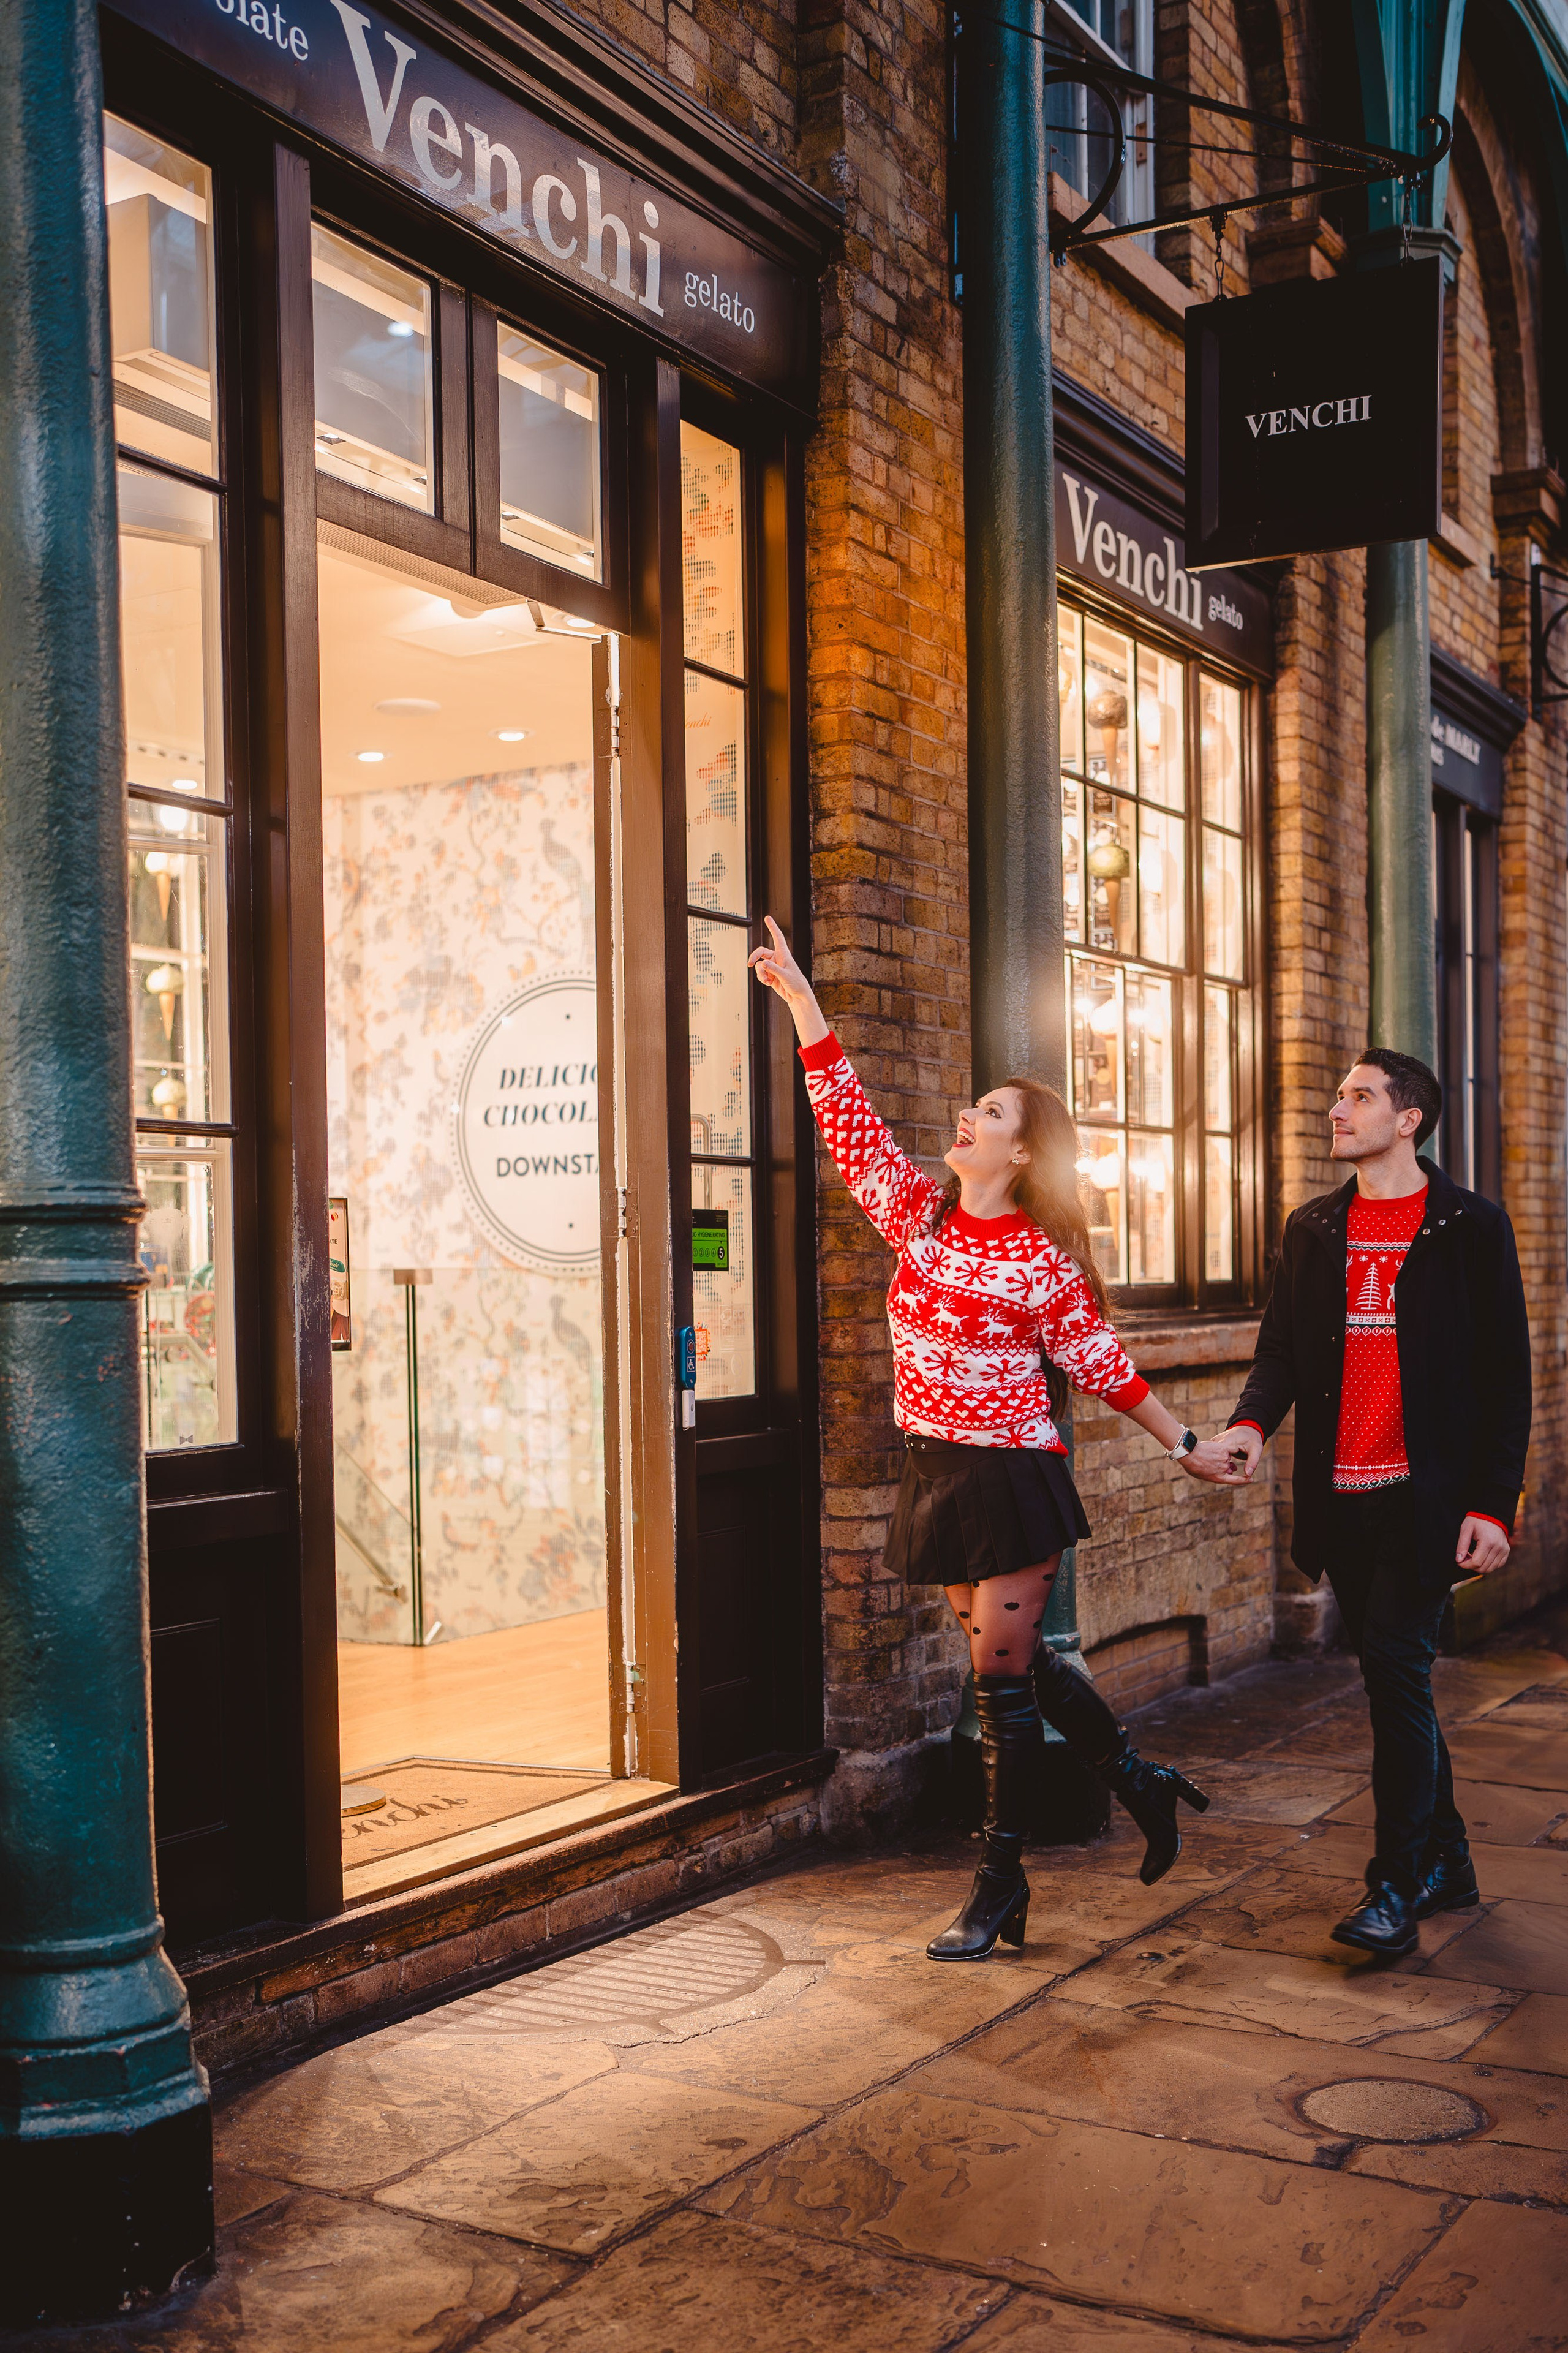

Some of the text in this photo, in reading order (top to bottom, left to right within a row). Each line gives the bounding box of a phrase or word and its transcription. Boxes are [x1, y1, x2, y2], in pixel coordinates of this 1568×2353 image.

[330, 0, 755, 333] Venchi gelato
[1245, 395, 1372, 438] VENCHI
[1062, 472, 1243, 632] Venchi gelato
[484, 1101, 598, 1126] CHOCOL
[497, 1154, 599, 1177] DOWNST
[718, 1248, 724, 1259] 5
